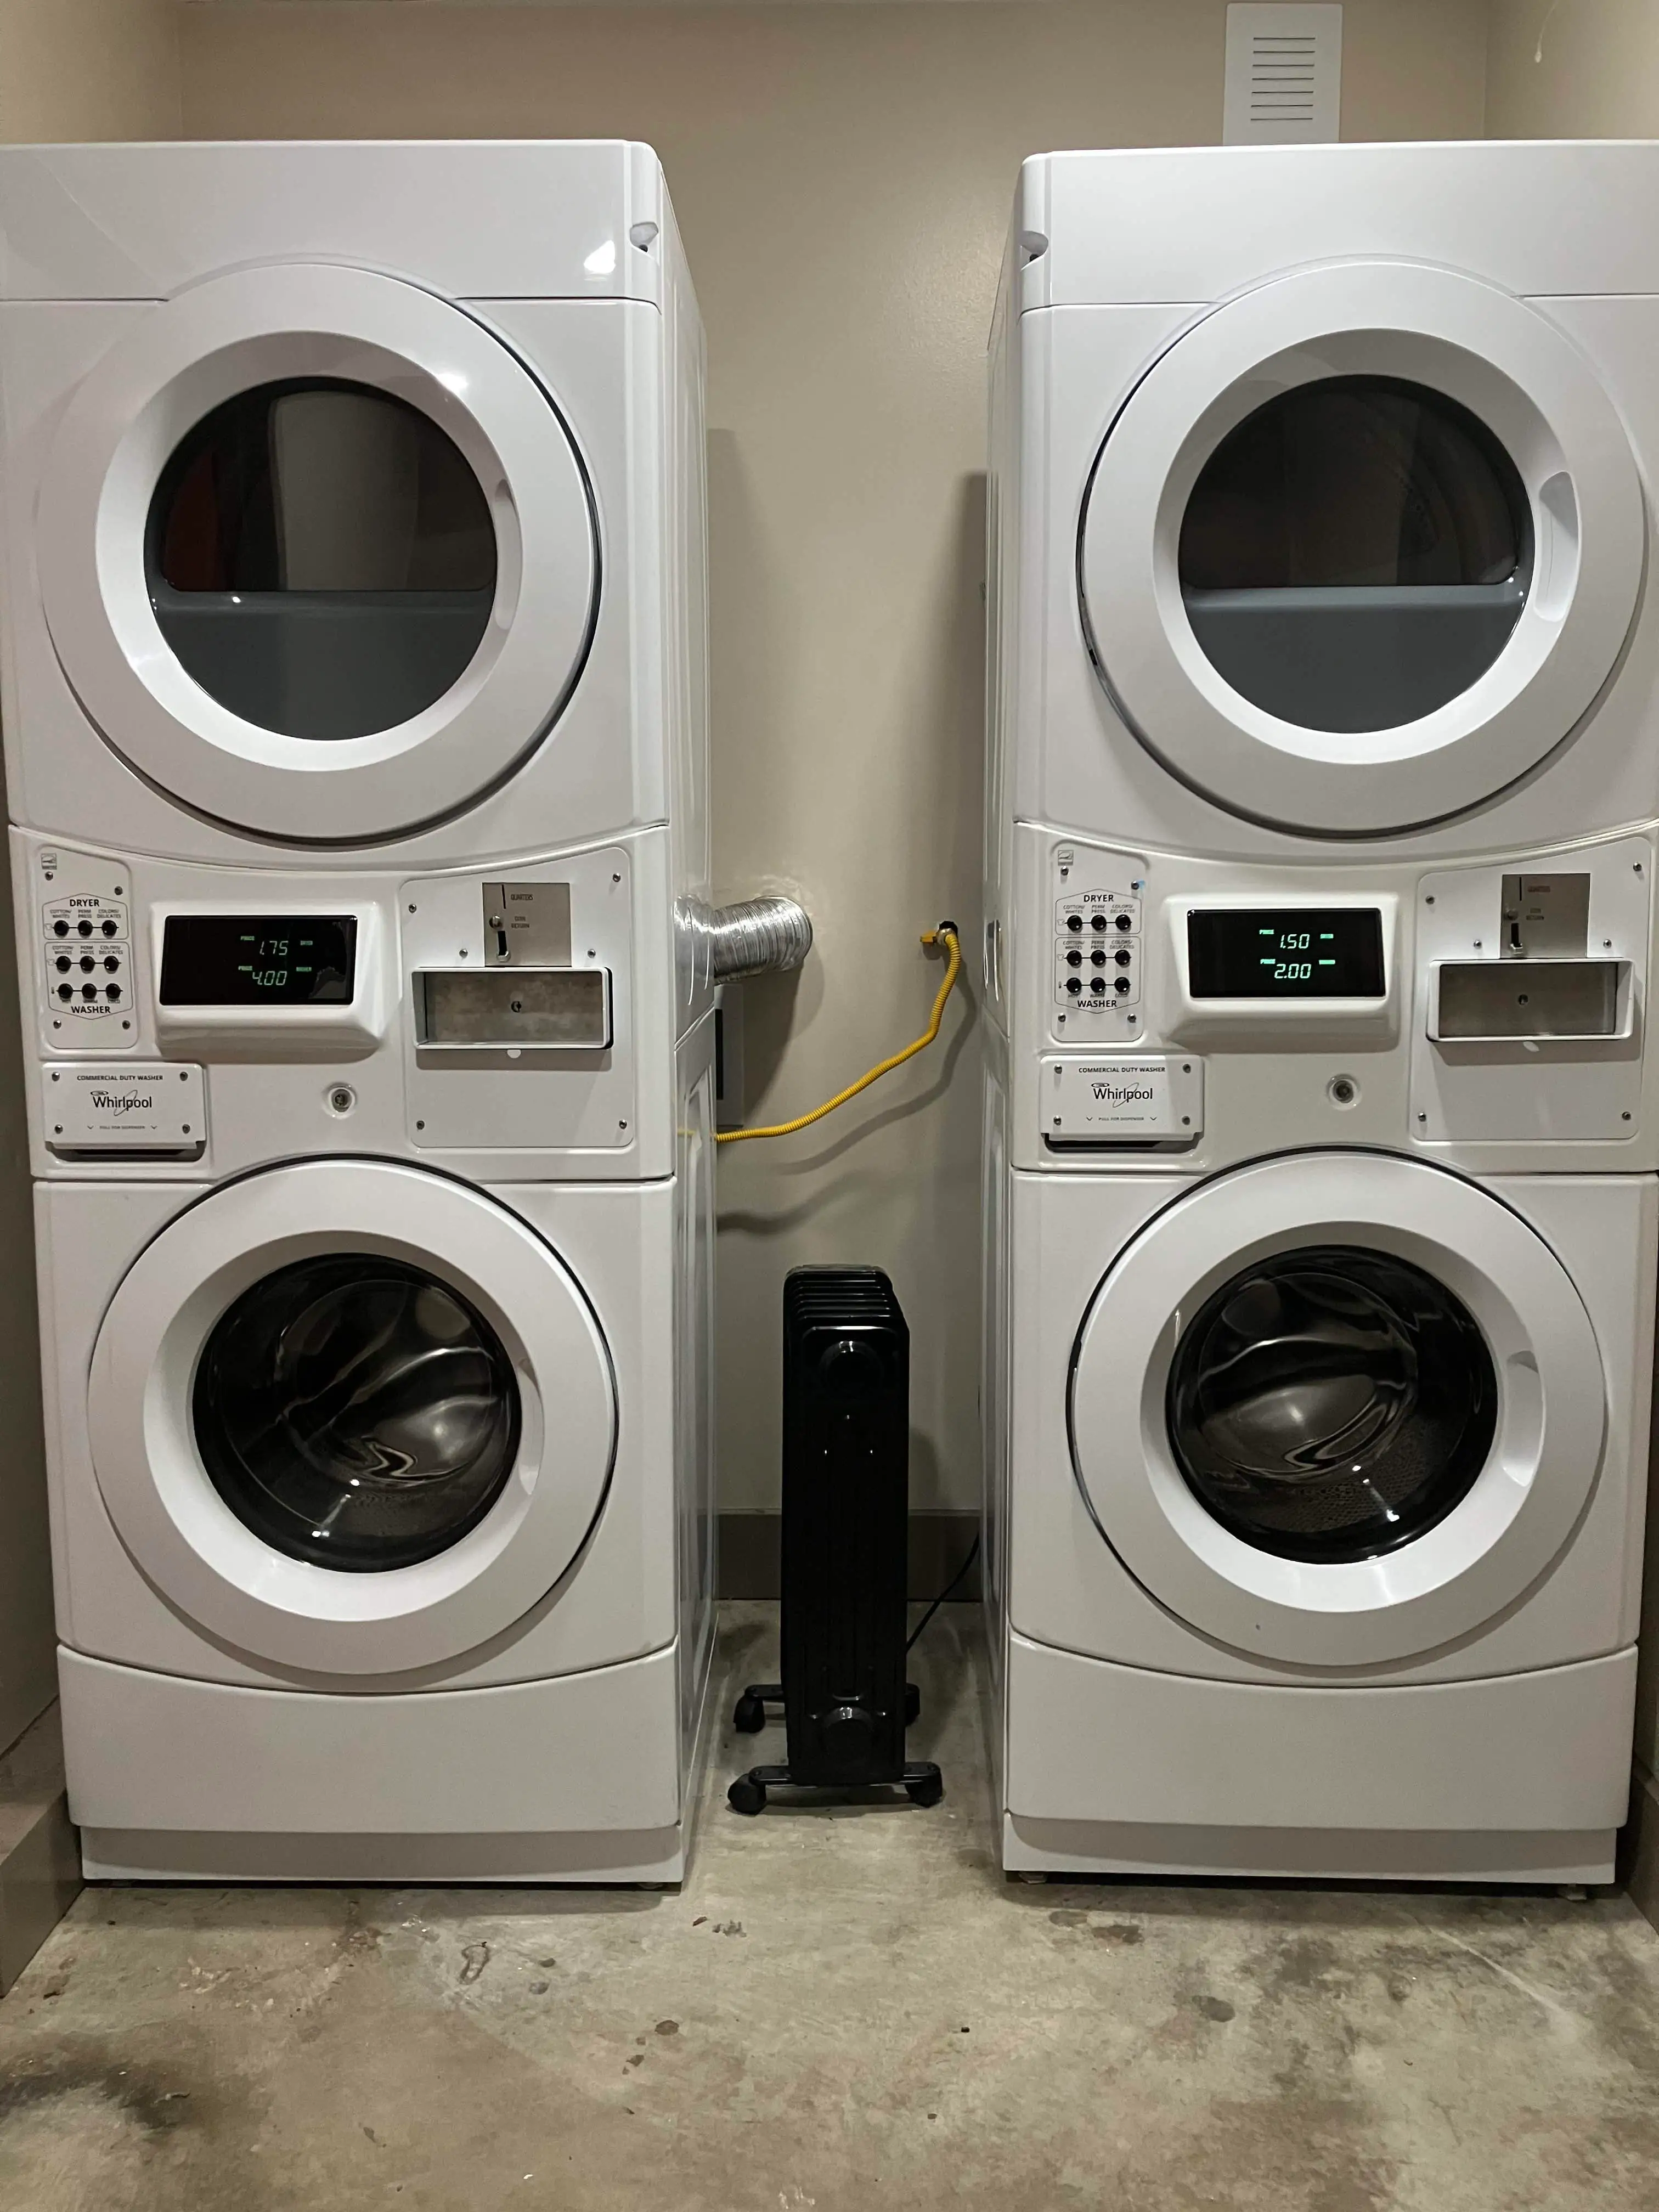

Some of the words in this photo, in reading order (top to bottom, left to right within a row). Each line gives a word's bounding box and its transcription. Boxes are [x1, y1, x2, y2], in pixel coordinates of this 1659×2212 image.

[259, 940, 289, 955] 1.75
[1280, 934, 1310, 949] 1.50
[252, 970, 287, 985] 4.00
[1274, 963, 1312, 979] 2.00
[1093, 1088, 1153, 1103] Whirlpool
[92, 1096, 152, 1111] Whirlpool
